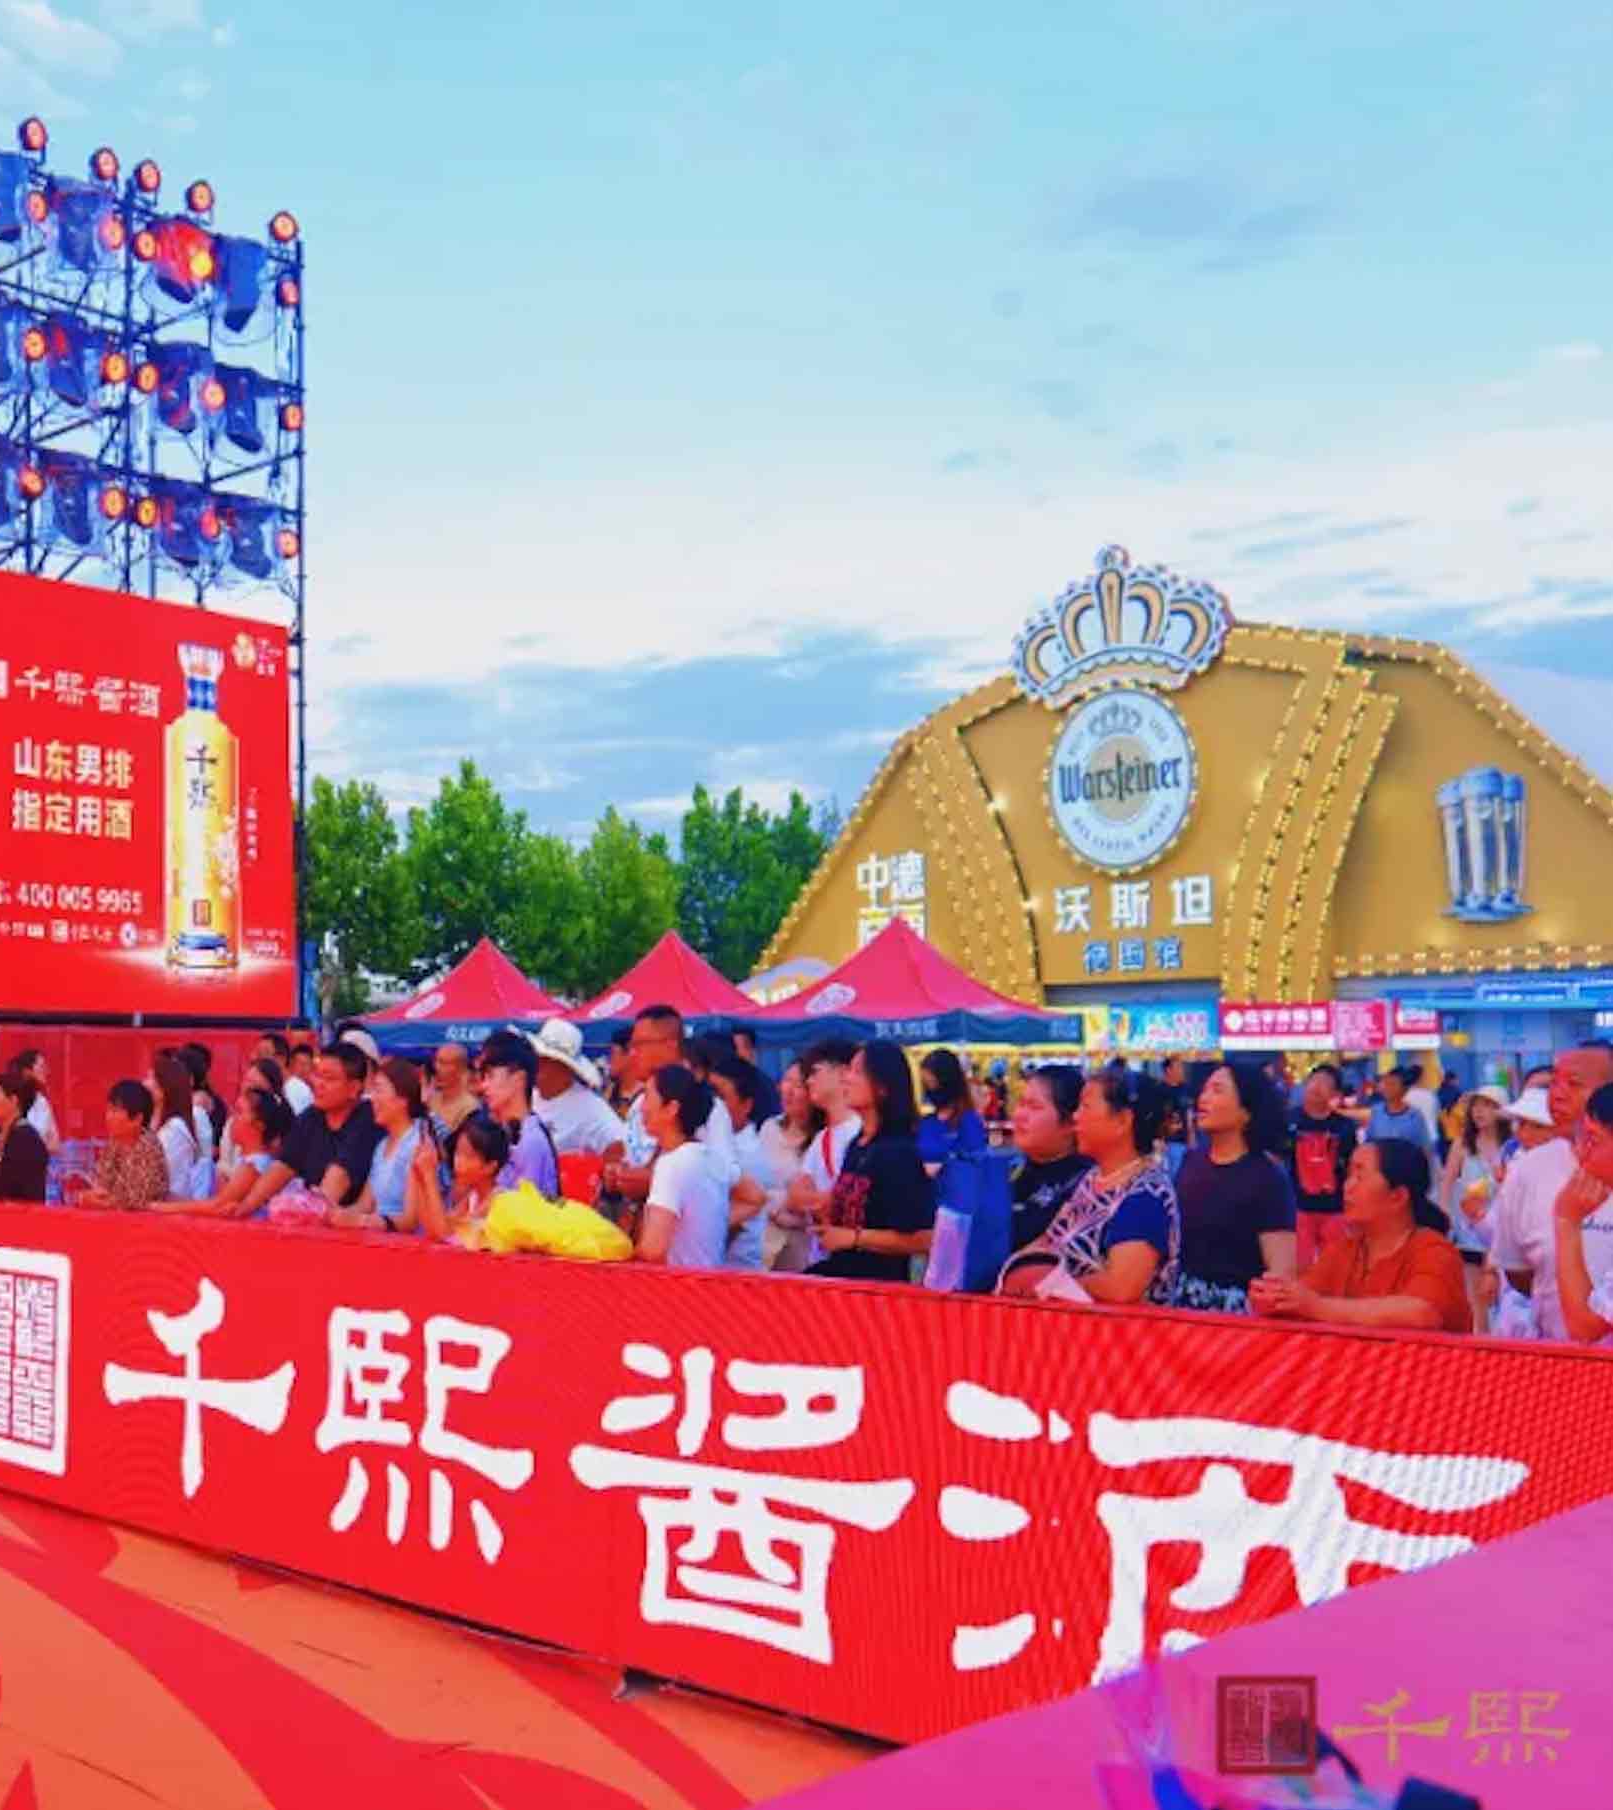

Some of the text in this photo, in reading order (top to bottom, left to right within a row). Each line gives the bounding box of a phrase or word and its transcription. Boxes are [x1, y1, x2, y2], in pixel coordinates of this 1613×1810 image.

[14, 665, 162, 719] 千熙酱酒
[12, 736, 136, 789] 山东男排
[1058, 751, 1183, 804] Warsteiner
[11, 790, 134, 841] 指定用酒
[18, 882, 53, 910] 400
[96, 887, 143, 915] 9965
[857, 851, 926, 908] 中德
[1054, 874, 1212, 935] 沃斯坦
[103, 1275, 1531, 1686] 千熙酱酒
